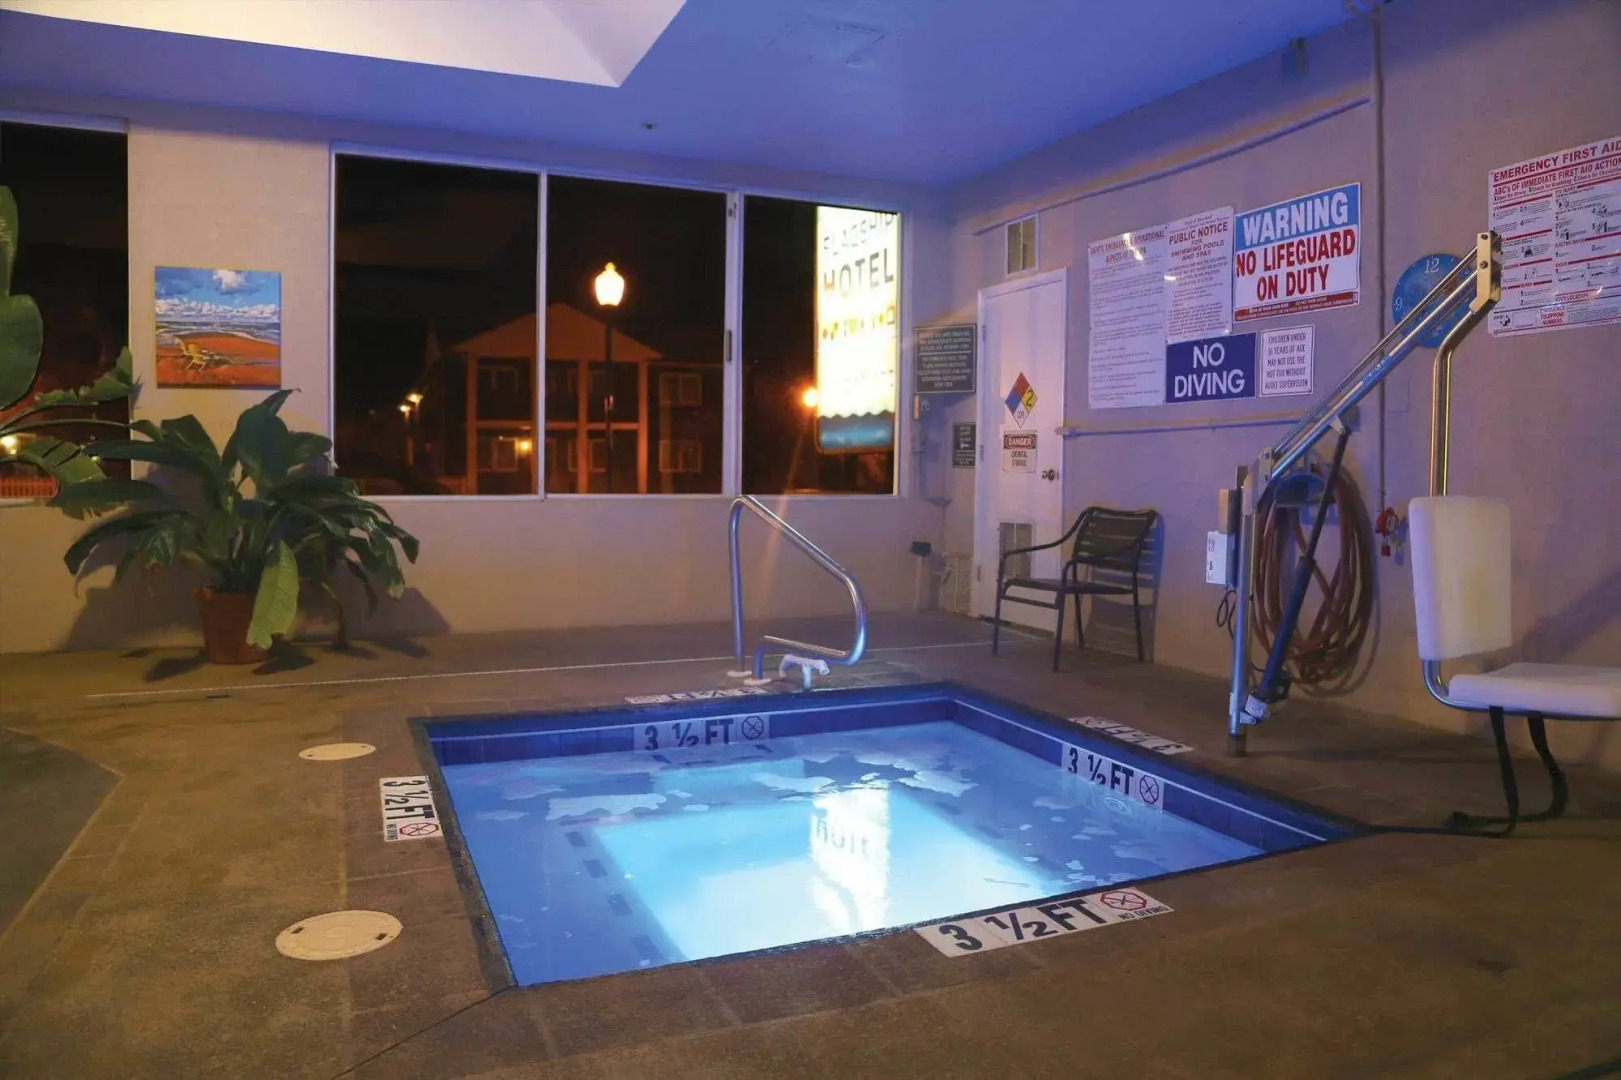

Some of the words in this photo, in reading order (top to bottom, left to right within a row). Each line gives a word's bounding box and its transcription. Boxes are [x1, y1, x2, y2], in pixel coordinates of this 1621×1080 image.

[1494, 156, 1559, 182] EMERGENCY
[1562, 146, 1598, 164] FIRST
[1511, 180, 1520, 192] OF
[1521, 173, 1557, 189] IMMEDIATE
[1558, 168, 1578, 179] FIRST
[1580, 163, 1593, 174] AID
[1595, 157, 1621, 171] ACTIO
[1243, 192, 1348, 246] WARNING
[1169, 230, 1196, 245] PUBLIC
[1197, 221, 1228, 239] NOTICE
[1170, 246, 1202, 258] SWIMMING
[1203, 240, 1225, 250] POOLS
[1182, 253, 1195, 261] AND
[1195, 250, 1212, 258] SPAS
[1236, 250, 1256, 277] NO
[1263, 229, 1356, 272] LIFEGUARD
[824, 248, 894, 298] HOTEL
[1424, 257, 1440, 273] 12
[1257, 274, 1278, 301] ON
[1286, 264, 1329, 297] DUTY
[1394, 296, 1403, 311] 9
[1290, 332, 1306, 342] UNDER
[1192, 342, 1225, 368] NO
[1274, 346, 1288, 355] YEARS
[1289, 344, 1295, 353] OF
[1297, 344, 1306, 352] AGE
[1267, 359, 1276, 367] MAY
[1277, 357, 1286, 366] NOT
[1287, 356, 1295, 365] USE
[1297, 355, 1306, 364] THE
[1174, 369, 1245, 398] DIVING
[1279, 379, 1308, 389] SUPERVISION
[1025, 389, 1034, 407] 2
[1008, 436, 1033, 446] DANGER
[644, 725, 659, 751] 3
[705, 718, 734, 745] FT
[1068, 748, 1079, 774] 3
[1111, 763, 1134, 795] FT
[385, 805, 435, 820] FT
[1117, 912, 1134, 920] NO
[1134, 905, 1170, 918] DIVING
[939, 924, 982, 951] 3
[1037, 899, 1107, 931] FT
